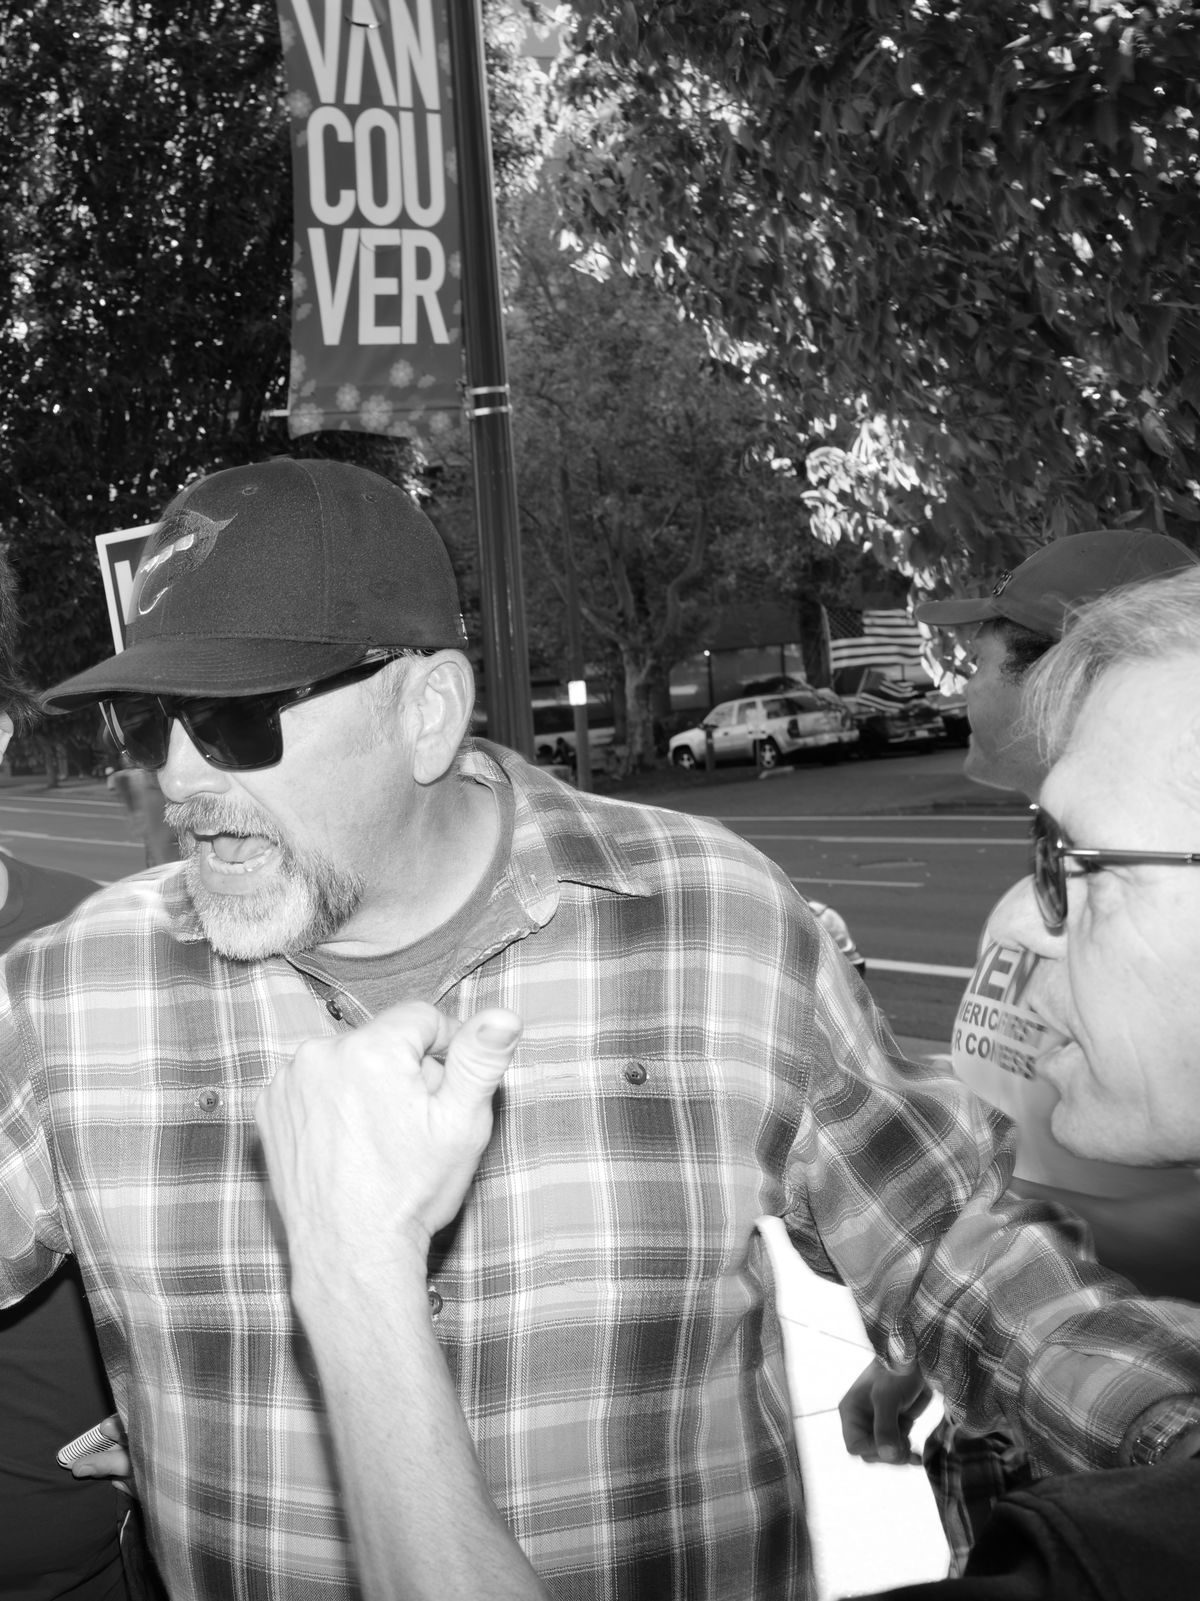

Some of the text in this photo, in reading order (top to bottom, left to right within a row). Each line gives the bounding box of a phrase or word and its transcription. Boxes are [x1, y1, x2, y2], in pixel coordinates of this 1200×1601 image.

[291, 0, 440, 110] VAN
[307, 106, 446, 228] COU
[306, 227, 450, 345] VER
